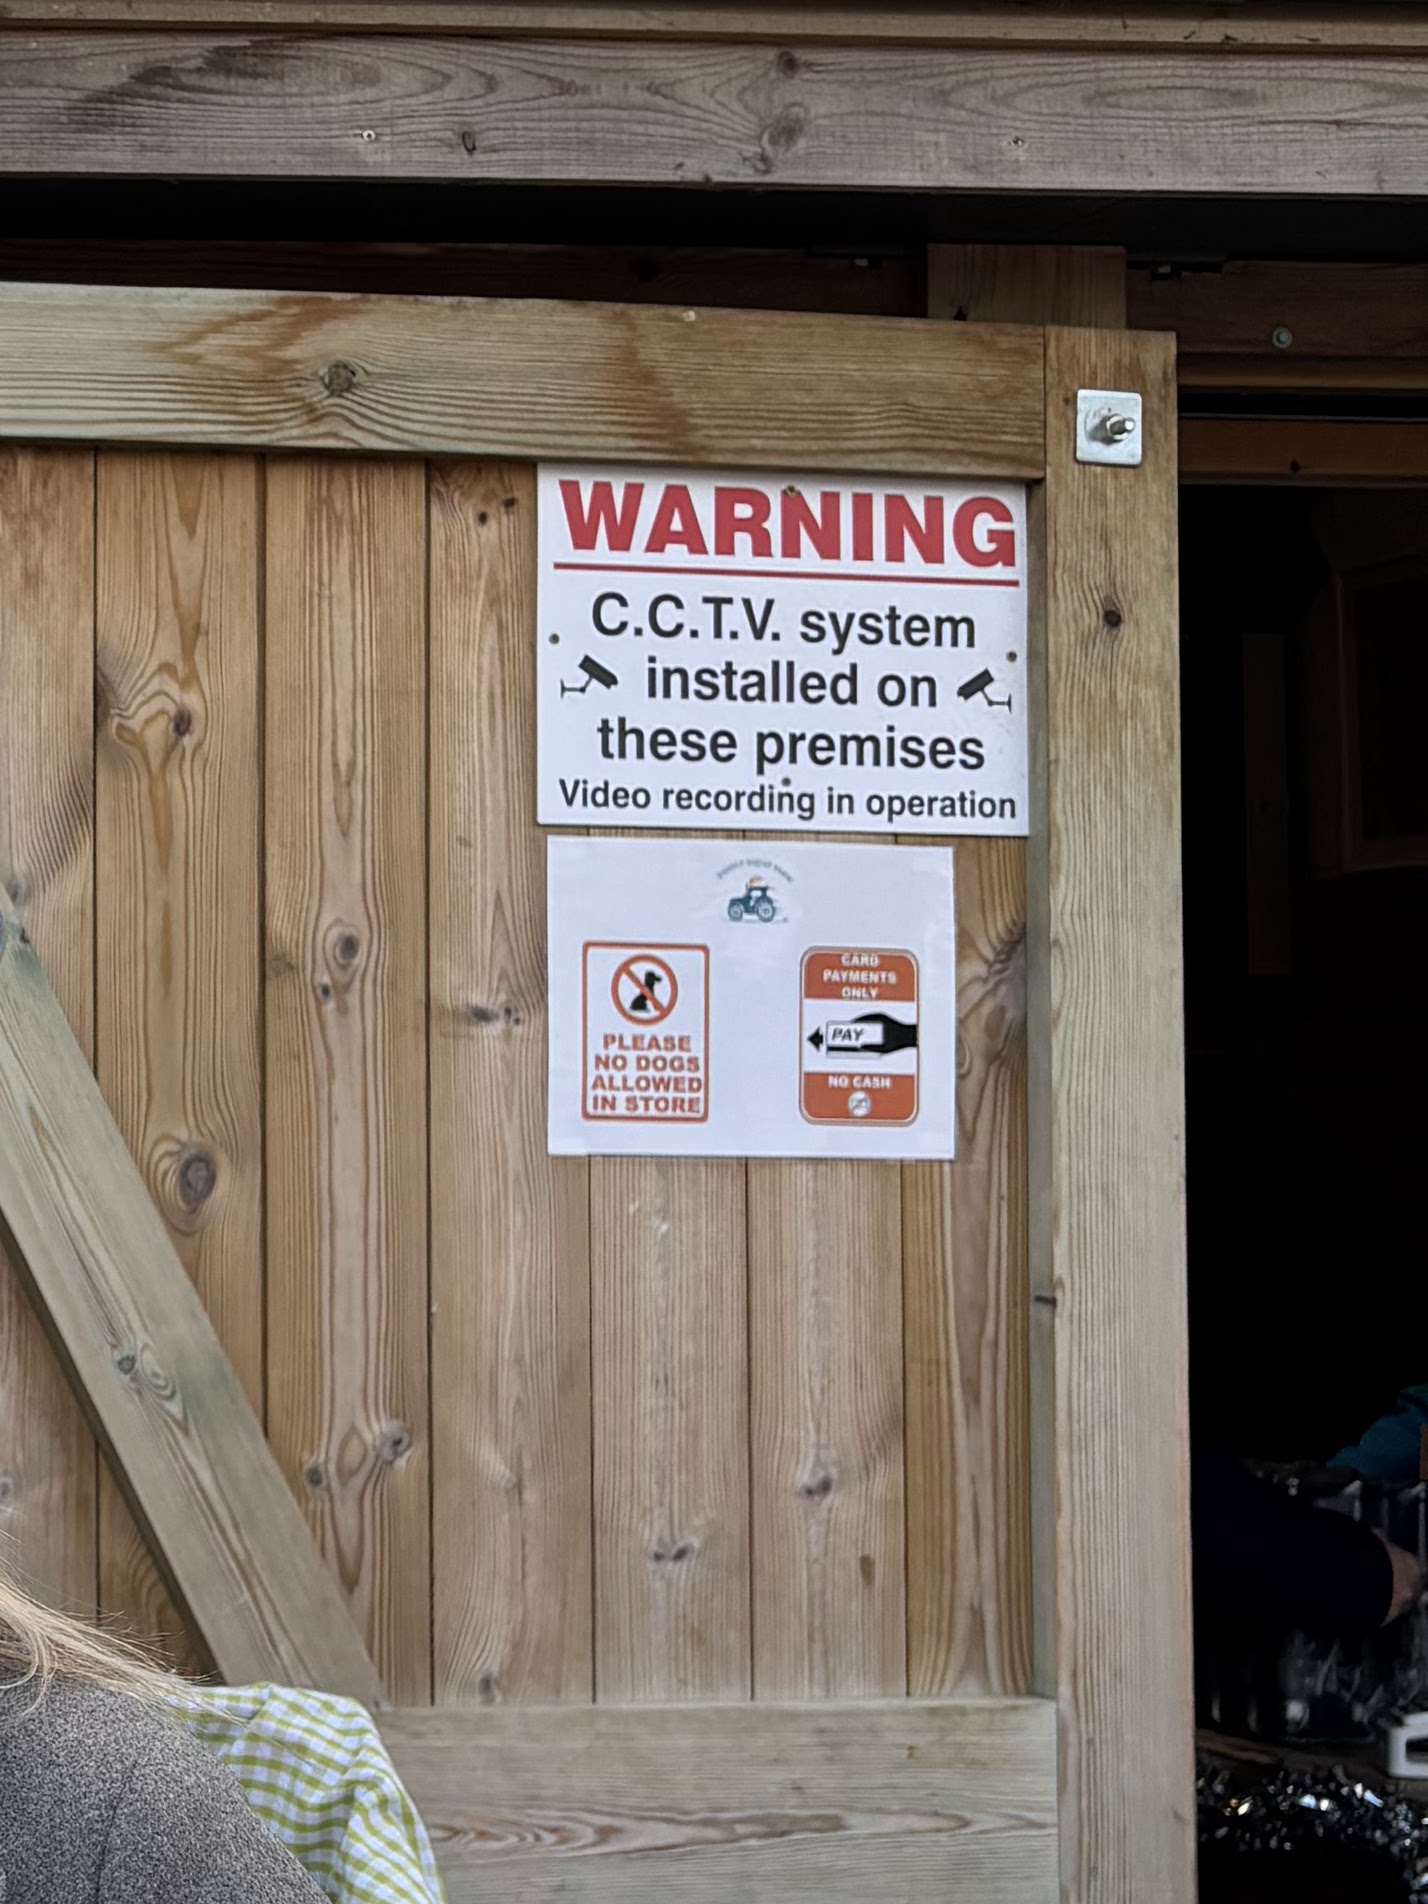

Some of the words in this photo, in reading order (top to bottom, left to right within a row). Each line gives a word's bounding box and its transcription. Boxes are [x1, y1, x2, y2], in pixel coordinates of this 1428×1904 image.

[558, 479, 1017, 568] WARNING
[591, 591, 782, 642] C.C.T.V.
[799, 605, 977, 656] system
[647, 656, 859, 706] installed
[876, 674, 938, 708] on
[597, 716, 738, 762] these
[755, 724, 986, 777] premises
[559, 778, 652, 810] Video
[662, 783, 815, 821] recording
[827, 786, 855, 817] in
[867, 788, 1017, 824] operation
[840, 953, 880, 968] CARD
[822, 968, 897, 985] PAYMENTS
[841, 986, 879, 1001] ONLY
[603, 1033, 692, 1053] PLEASE
[831, 1026, 864, 1043] PAY
[594, 1053, 628, 1072] NO
[635, 1055, 700, 1073] DOGS
[592, 1073, 702, 1094] ALLOWED
[828, 1074, 850, 1090] NO
[852, 1075, 892, 1090] CASH
[593, 1094, 616, 1112] IN
[625, 1095, 701, 1114] STORE
